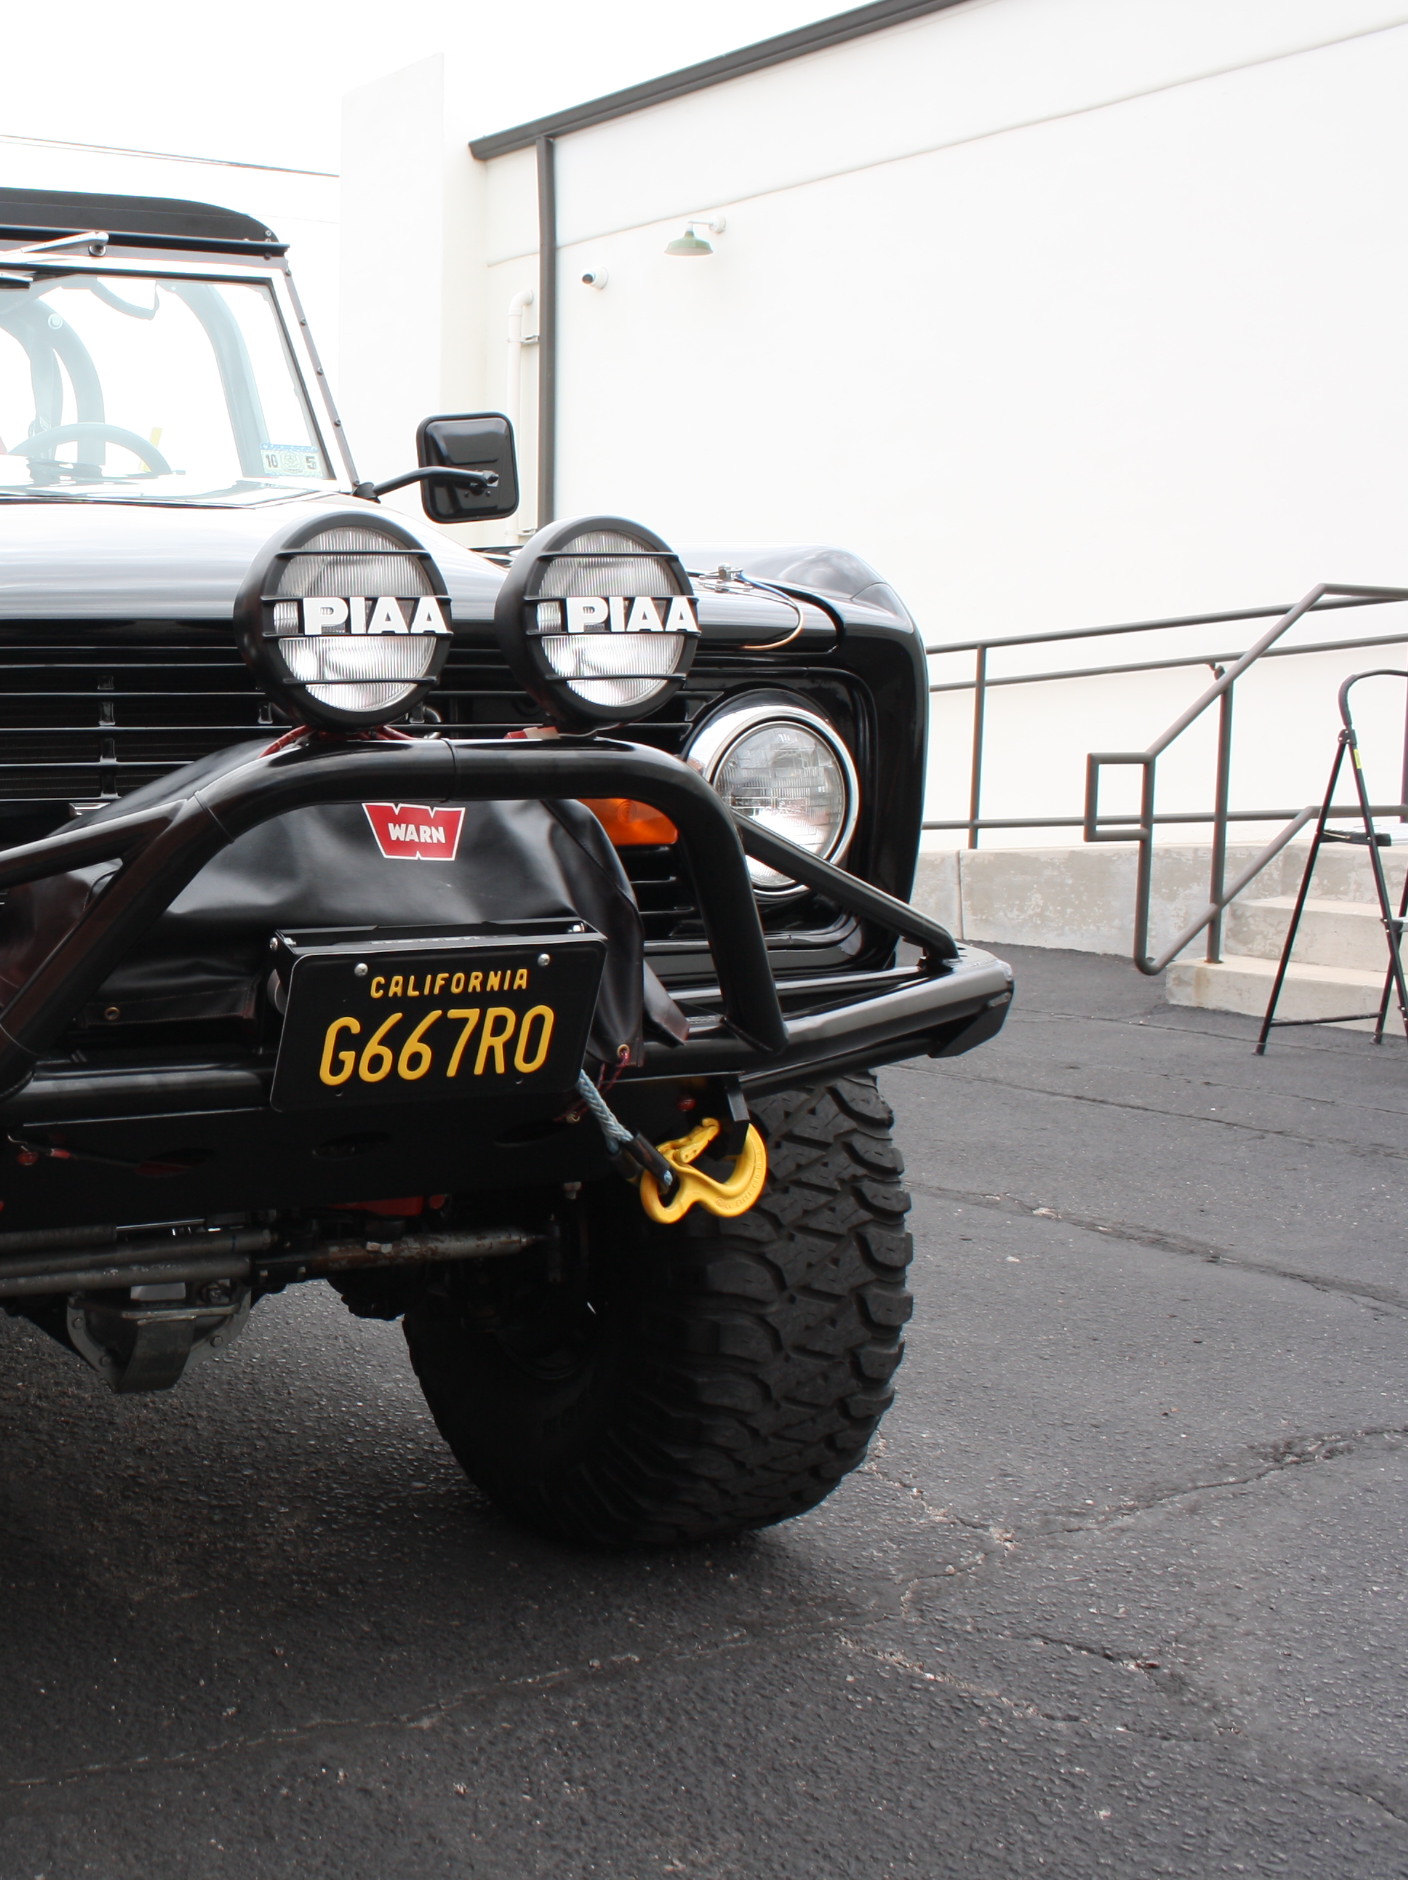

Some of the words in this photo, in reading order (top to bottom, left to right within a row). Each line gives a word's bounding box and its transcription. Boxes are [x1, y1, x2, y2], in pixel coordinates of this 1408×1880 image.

[302, 595, 448, 635] PIAA
[566, 595, 701, 634] PIAA
[388, 821, 446, 845] WARN
[370, 968, 529, 999] CALIFORNIA
